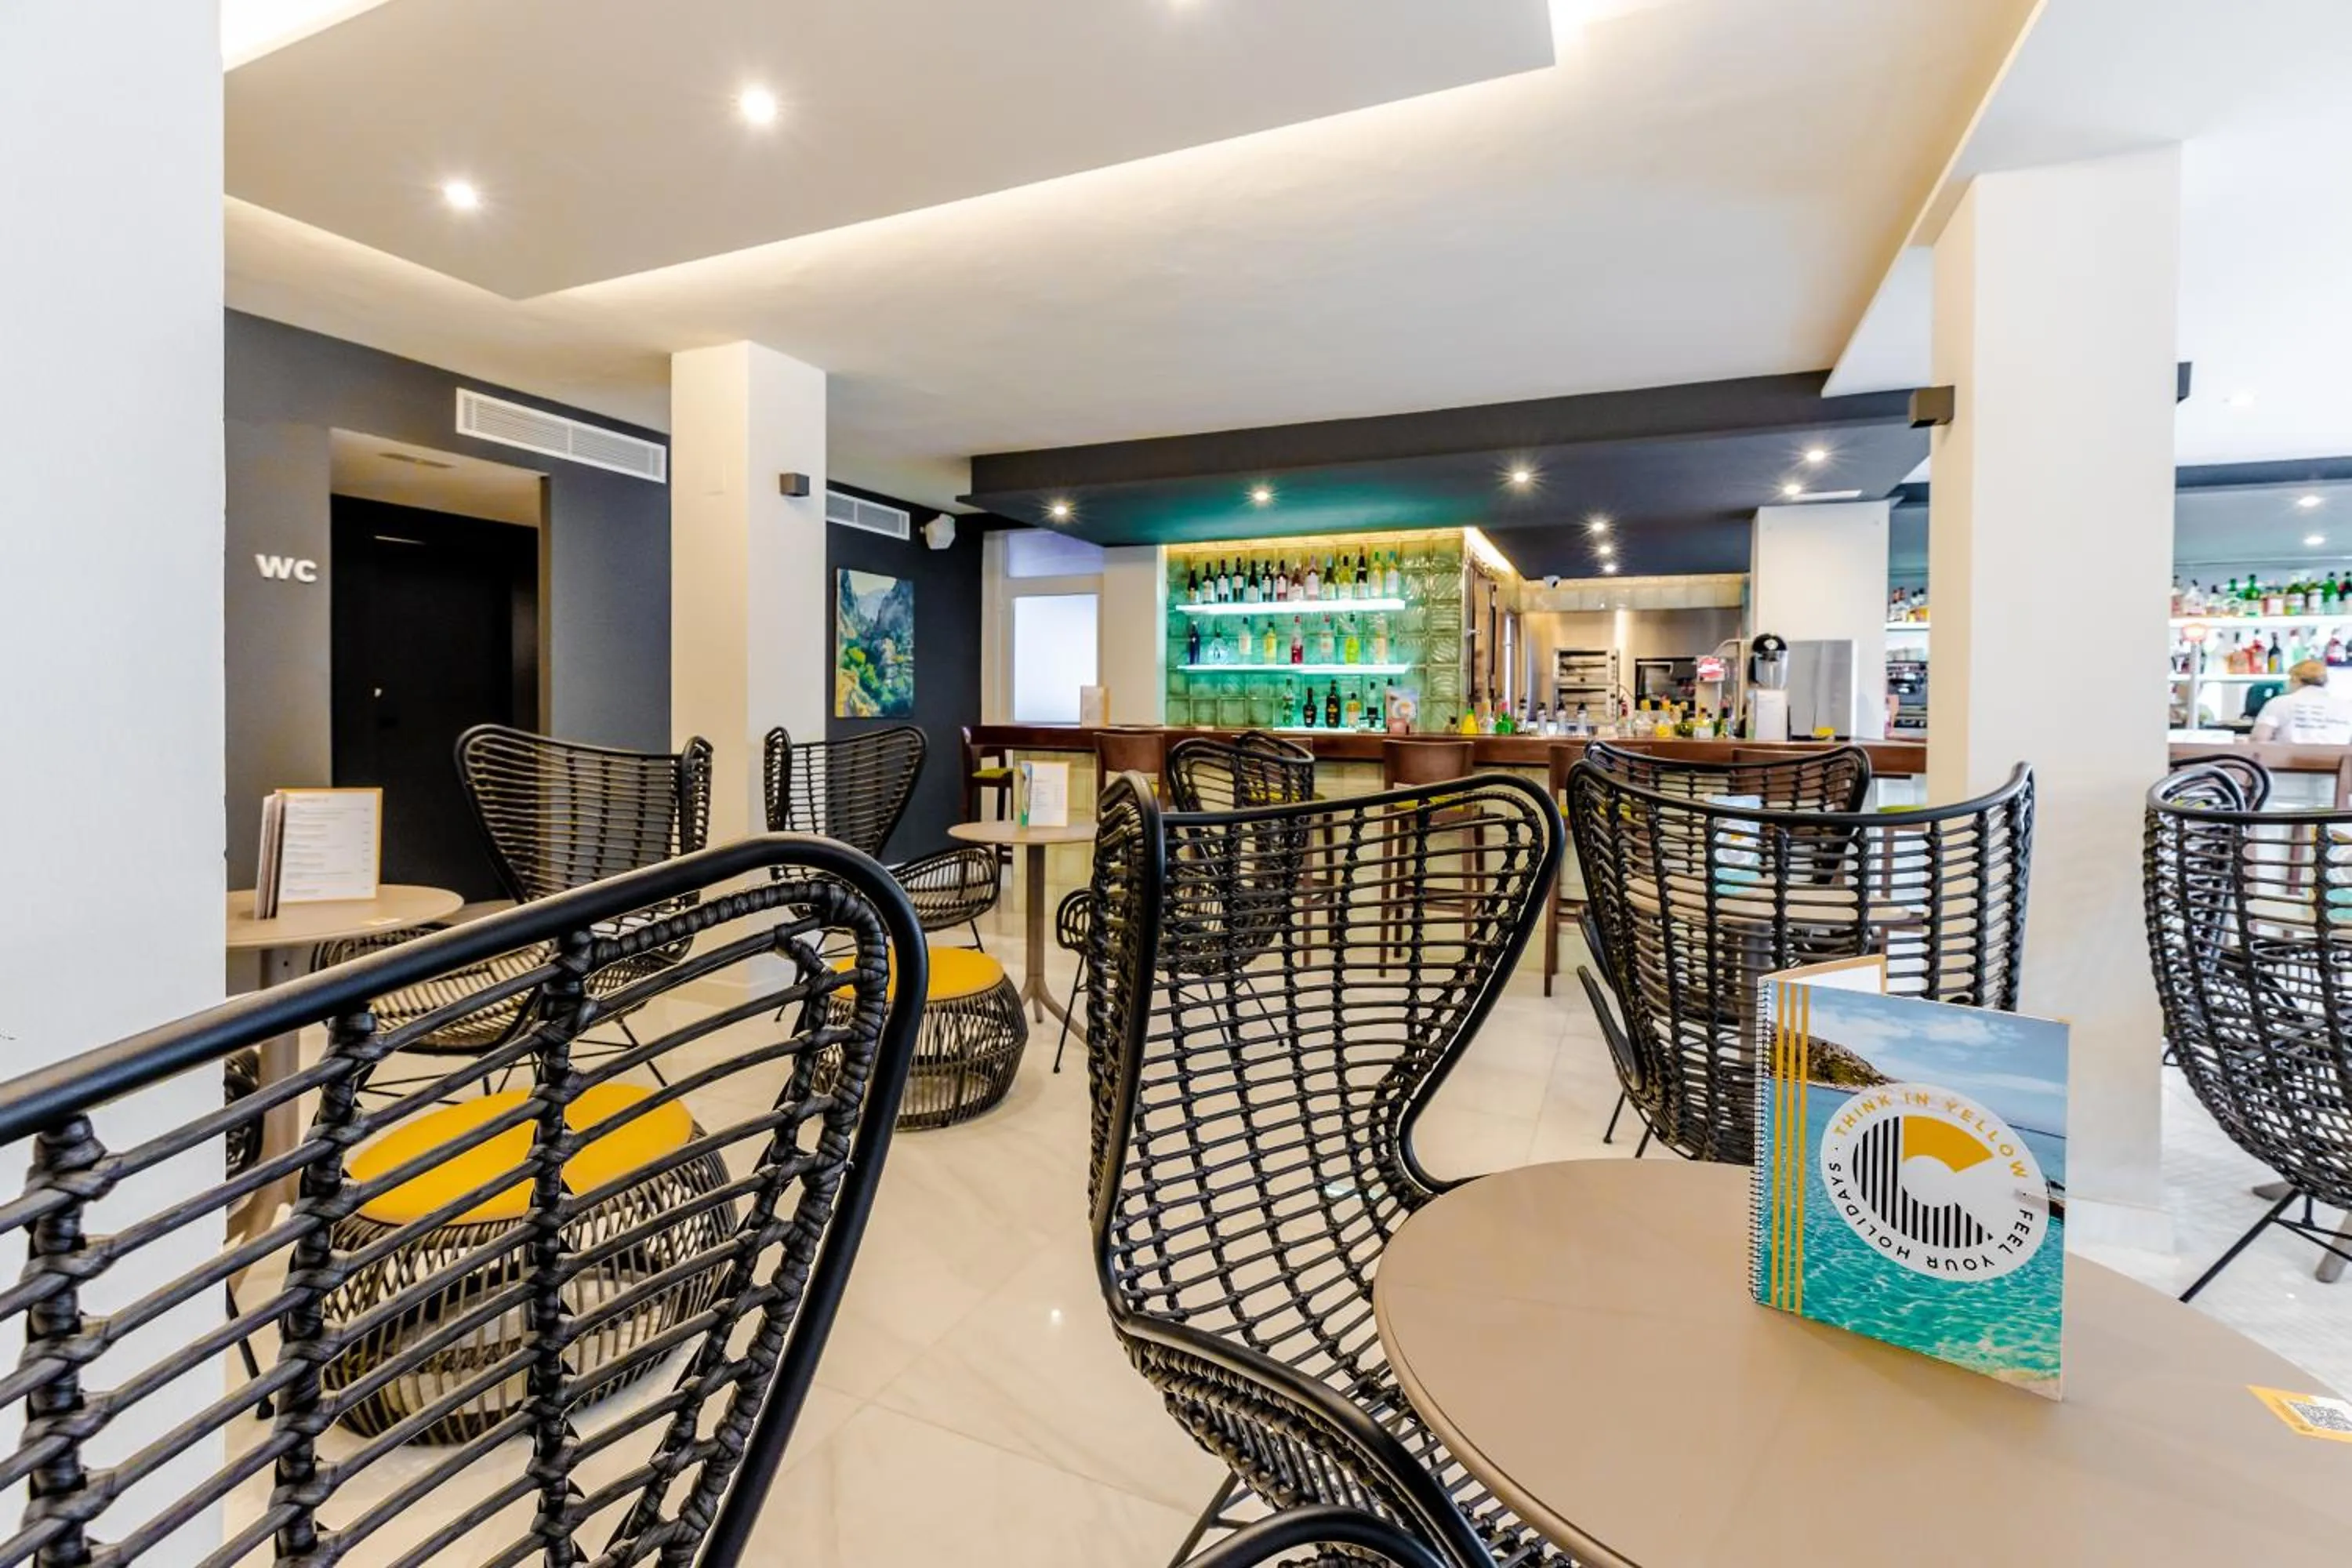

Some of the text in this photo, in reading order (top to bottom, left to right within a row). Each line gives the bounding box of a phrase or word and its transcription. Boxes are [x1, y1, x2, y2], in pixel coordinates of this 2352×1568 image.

[255, 554, 317, 583] WC
[1832, 1092, 2028, 1178] THINK IN YELLOW
[1828, 1163, 2034, 1272] FEEL YOUR HOLIDAYS
